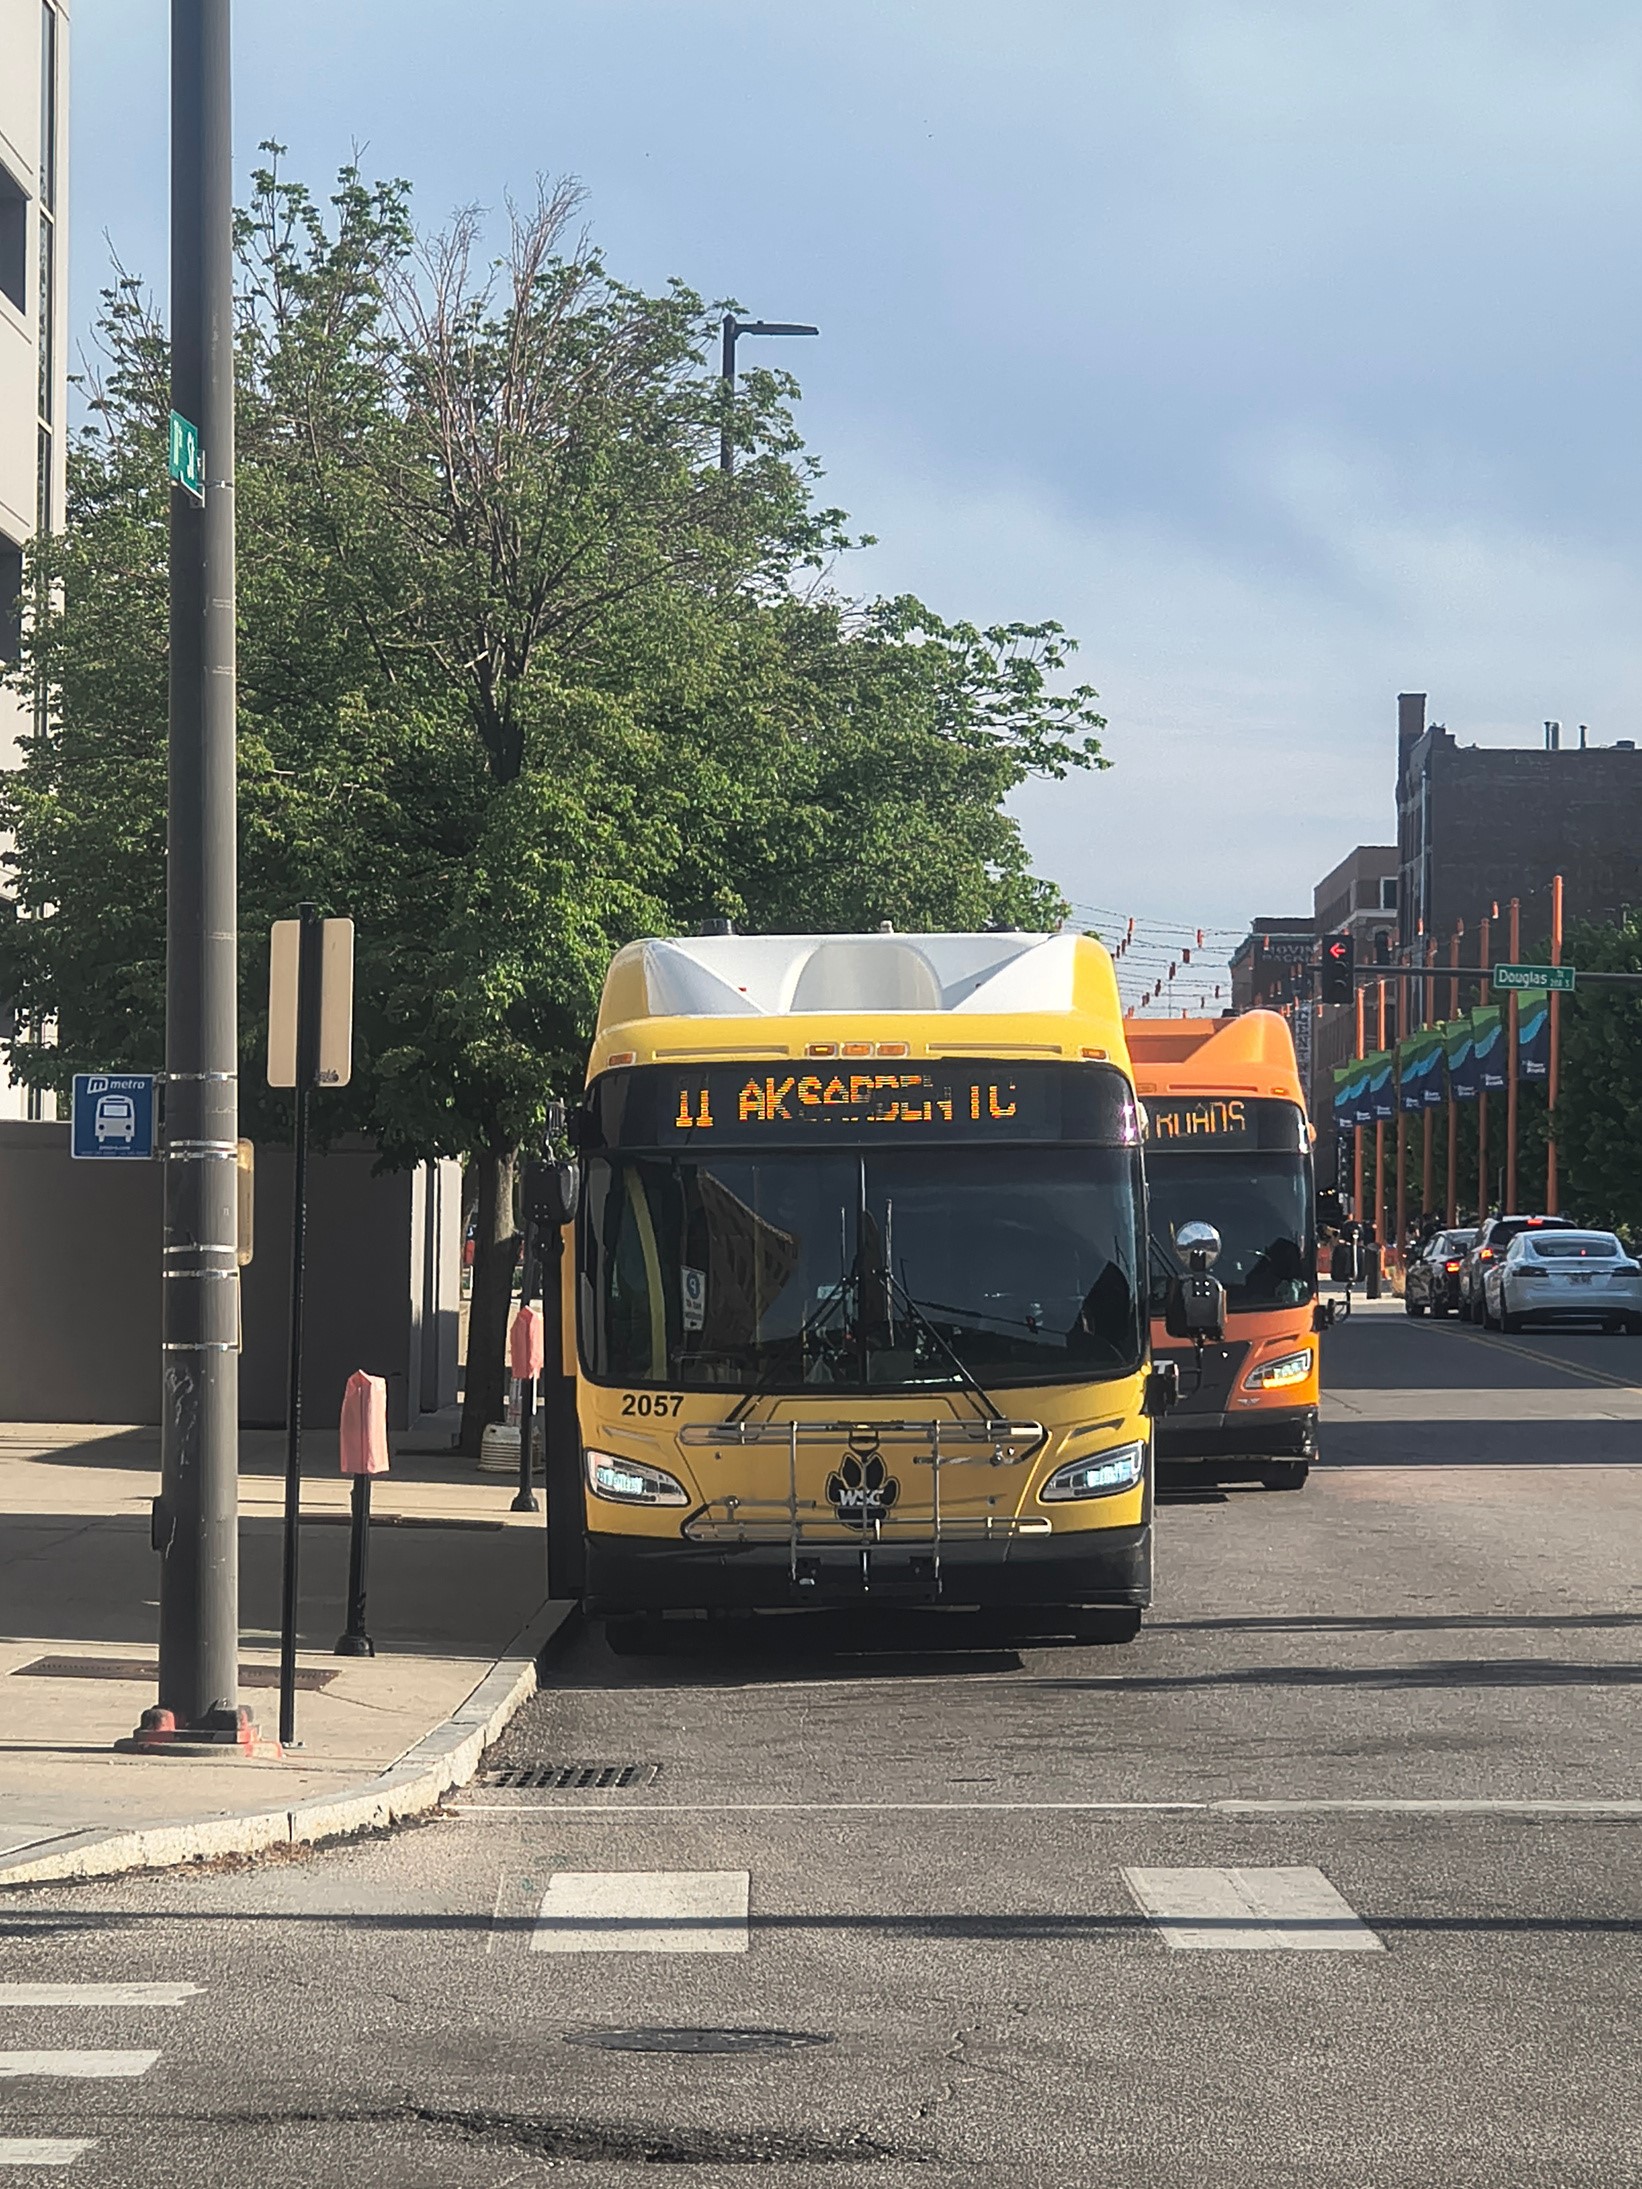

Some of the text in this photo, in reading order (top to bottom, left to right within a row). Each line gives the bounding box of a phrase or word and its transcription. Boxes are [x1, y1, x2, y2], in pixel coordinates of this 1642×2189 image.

[1499, 969, 1547, 987] Douglas
[110, 1080, 145, 1089] metro
[622, 1394, 684, 1417] 2057
[839, 1489, 885, 1506] WSC
